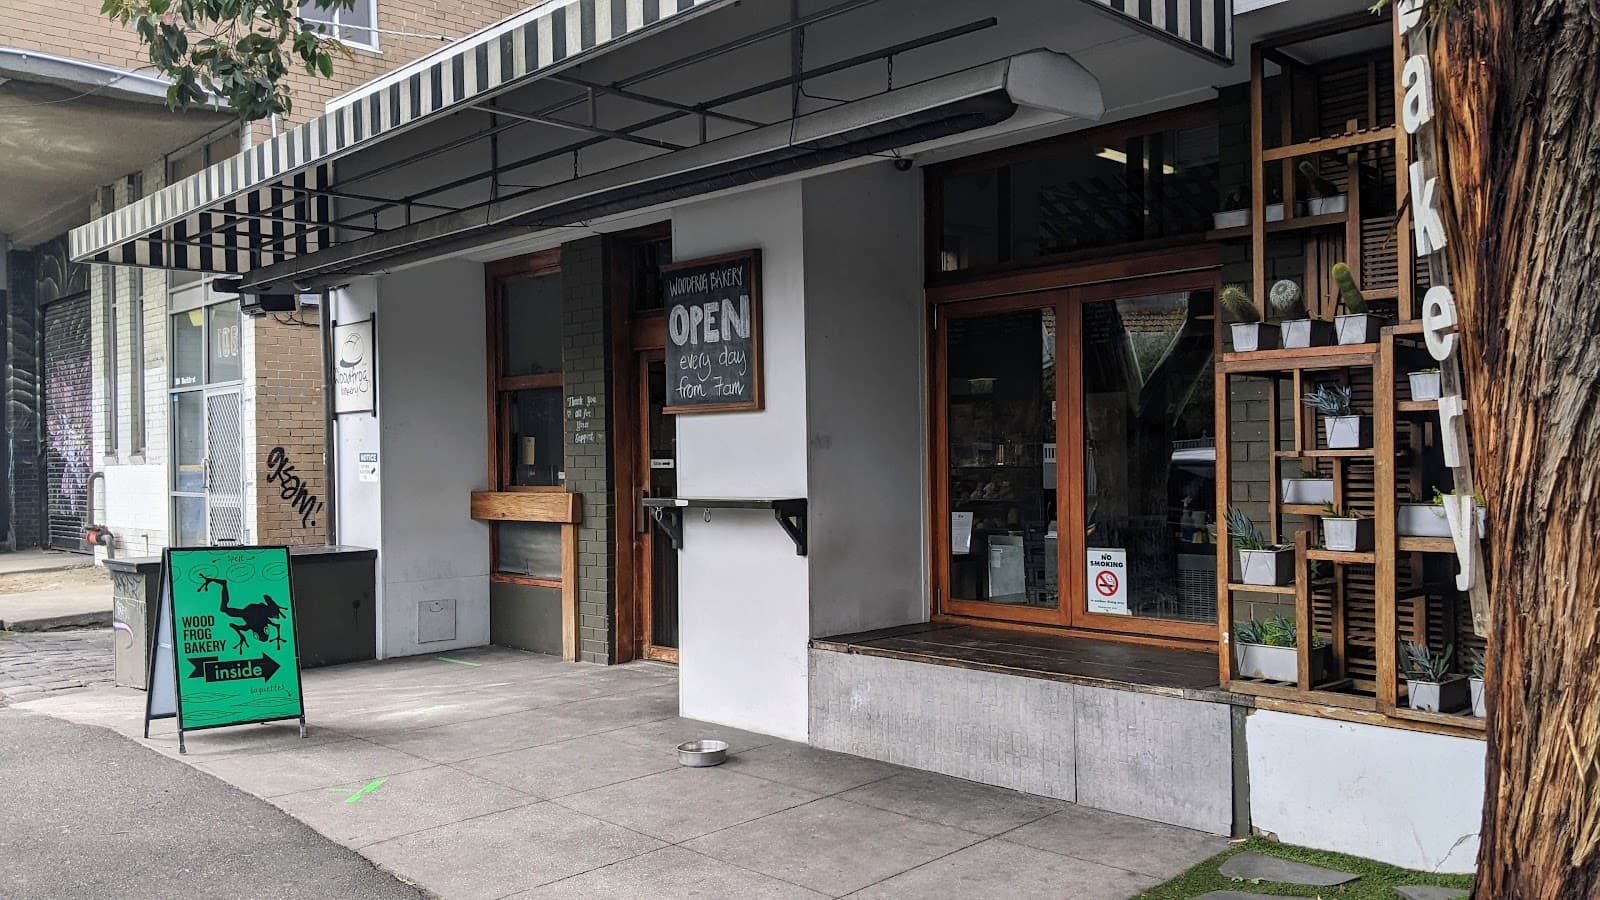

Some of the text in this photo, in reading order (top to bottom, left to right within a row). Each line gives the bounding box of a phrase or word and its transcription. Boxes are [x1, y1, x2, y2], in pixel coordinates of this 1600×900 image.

[669, 265, 743, 297] WOODFROG BAKERY
[669, 294, 750, 346] OPEN
[680, 345, 747, 382] every day
[675, 375, 745, 400] from 7am
[182, 615, 215, 629] WOOD
[183, 628, 212, 642] FROG
[184, 640, 226, 654] BAKERY
[215, 661, 262, 680] inside
